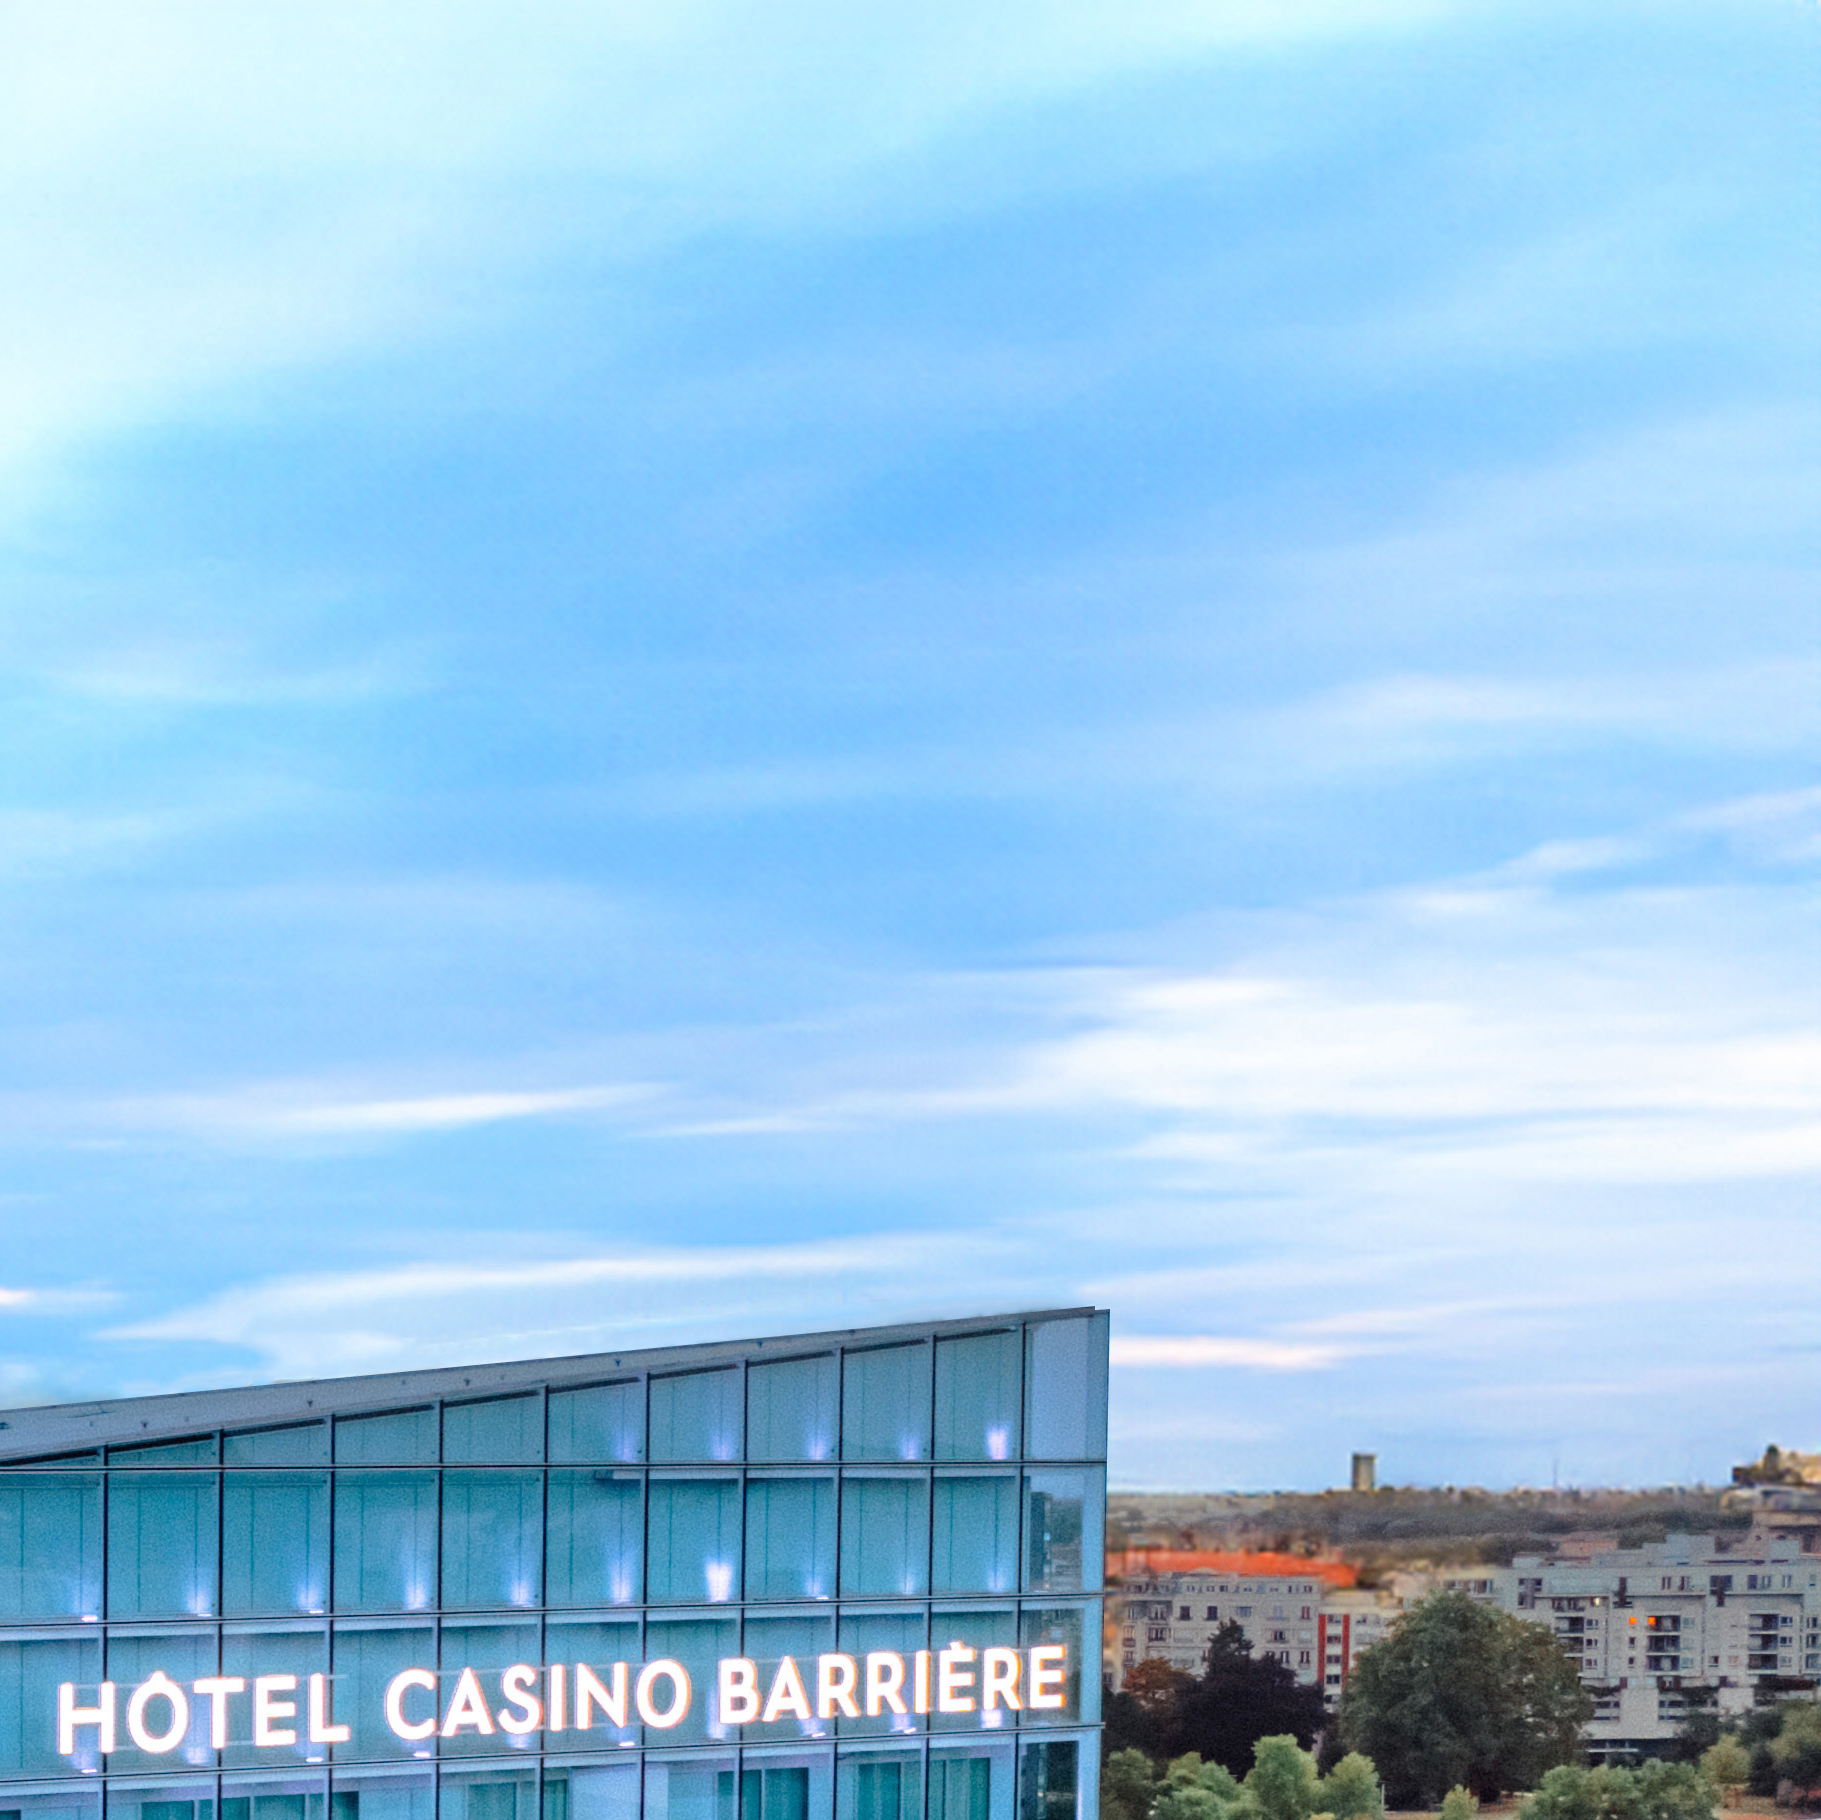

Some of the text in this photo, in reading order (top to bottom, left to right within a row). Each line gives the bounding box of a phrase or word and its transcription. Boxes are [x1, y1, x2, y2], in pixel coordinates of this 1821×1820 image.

[58, 1641, 1066, 1756] HÔTEL CASINO BARRIÈRE
